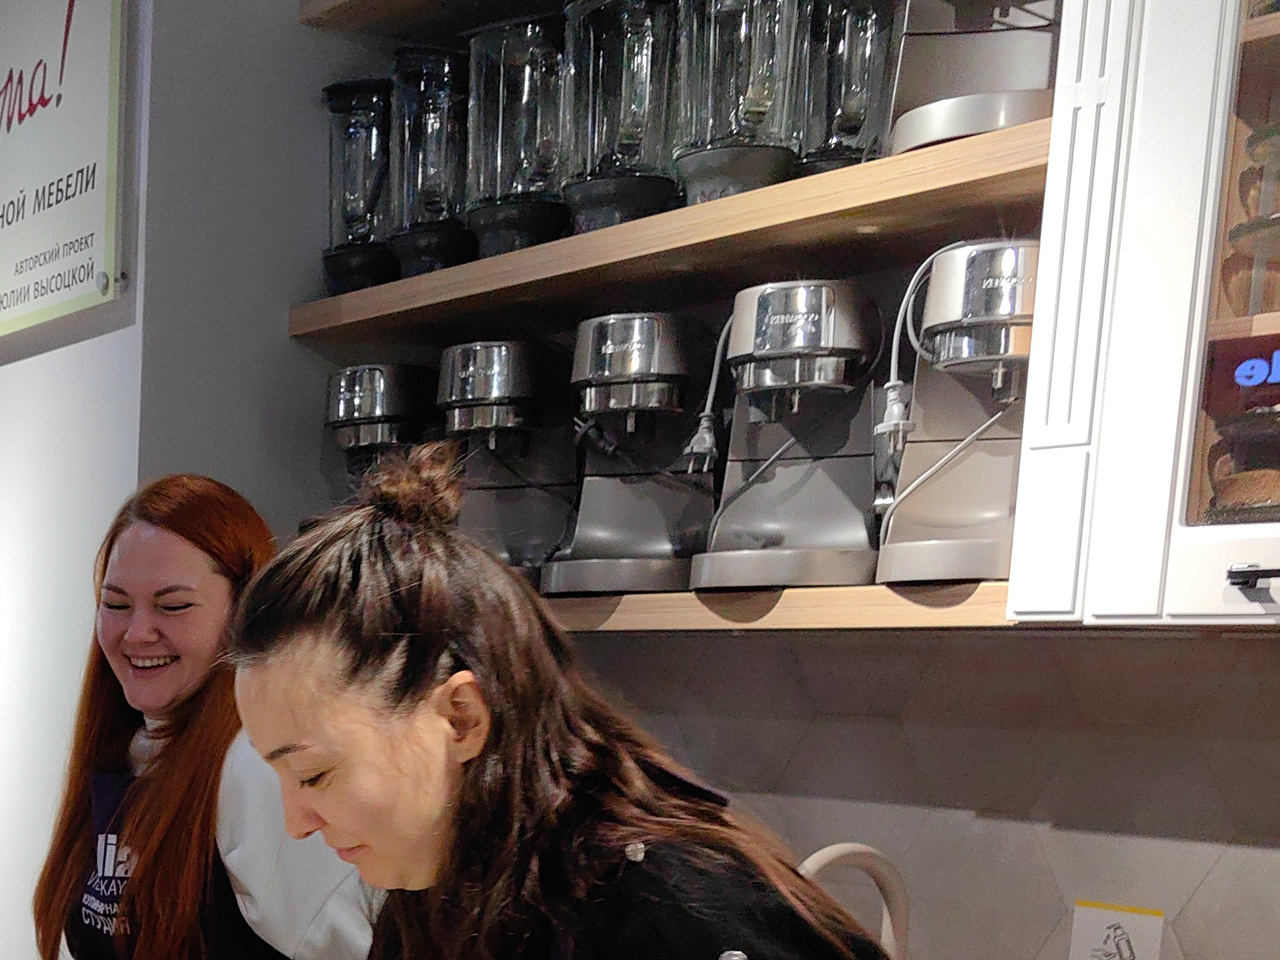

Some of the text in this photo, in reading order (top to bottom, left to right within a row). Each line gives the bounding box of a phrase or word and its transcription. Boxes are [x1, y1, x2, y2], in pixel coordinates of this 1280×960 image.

[32, 162, 97, 215] МЕБЕЛИ
[13, 232, 95, 277] АВТОРСКИЙ ПРОЕКТ
[0, 257, 95, 312] ЮЛИИ ВЫСОЦКОЙ
[97, 833, 140, 877] lia
